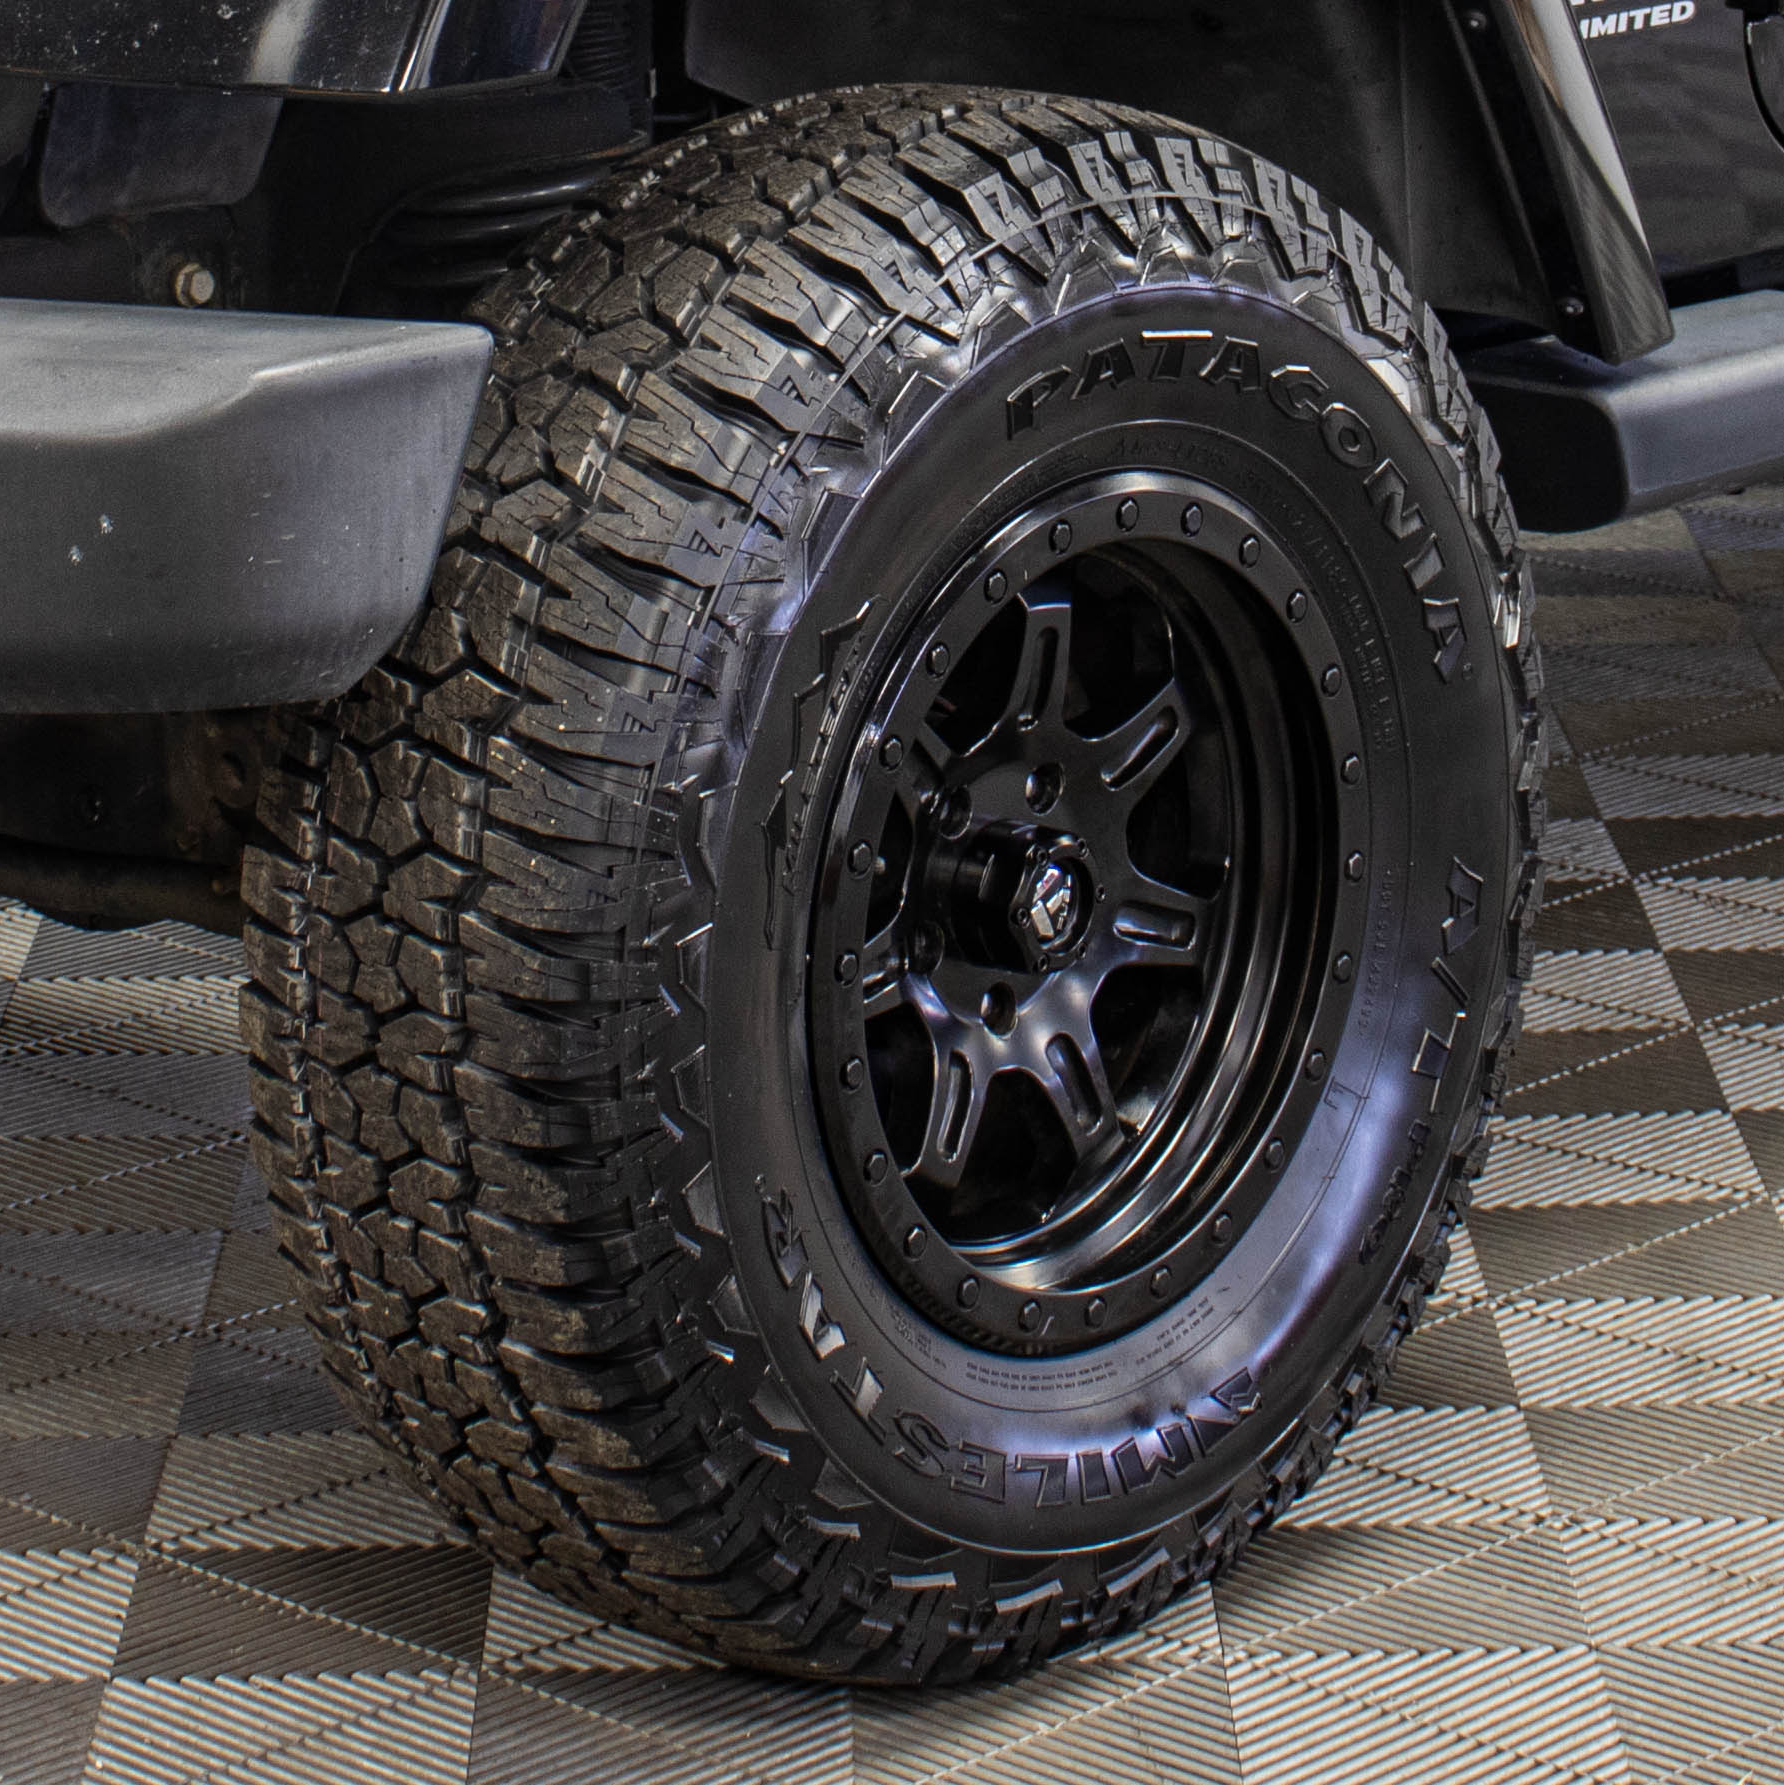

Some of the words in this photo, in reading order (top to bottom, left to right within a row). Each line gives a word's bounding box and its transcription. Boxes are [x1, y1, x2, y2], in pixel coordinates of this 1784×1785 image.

[1579, 0, 1695, 40] IMITED
[1005, 329, 1467, 683] PATAGONIA
[762, 1187, 1196, 1507] MILESTAR
